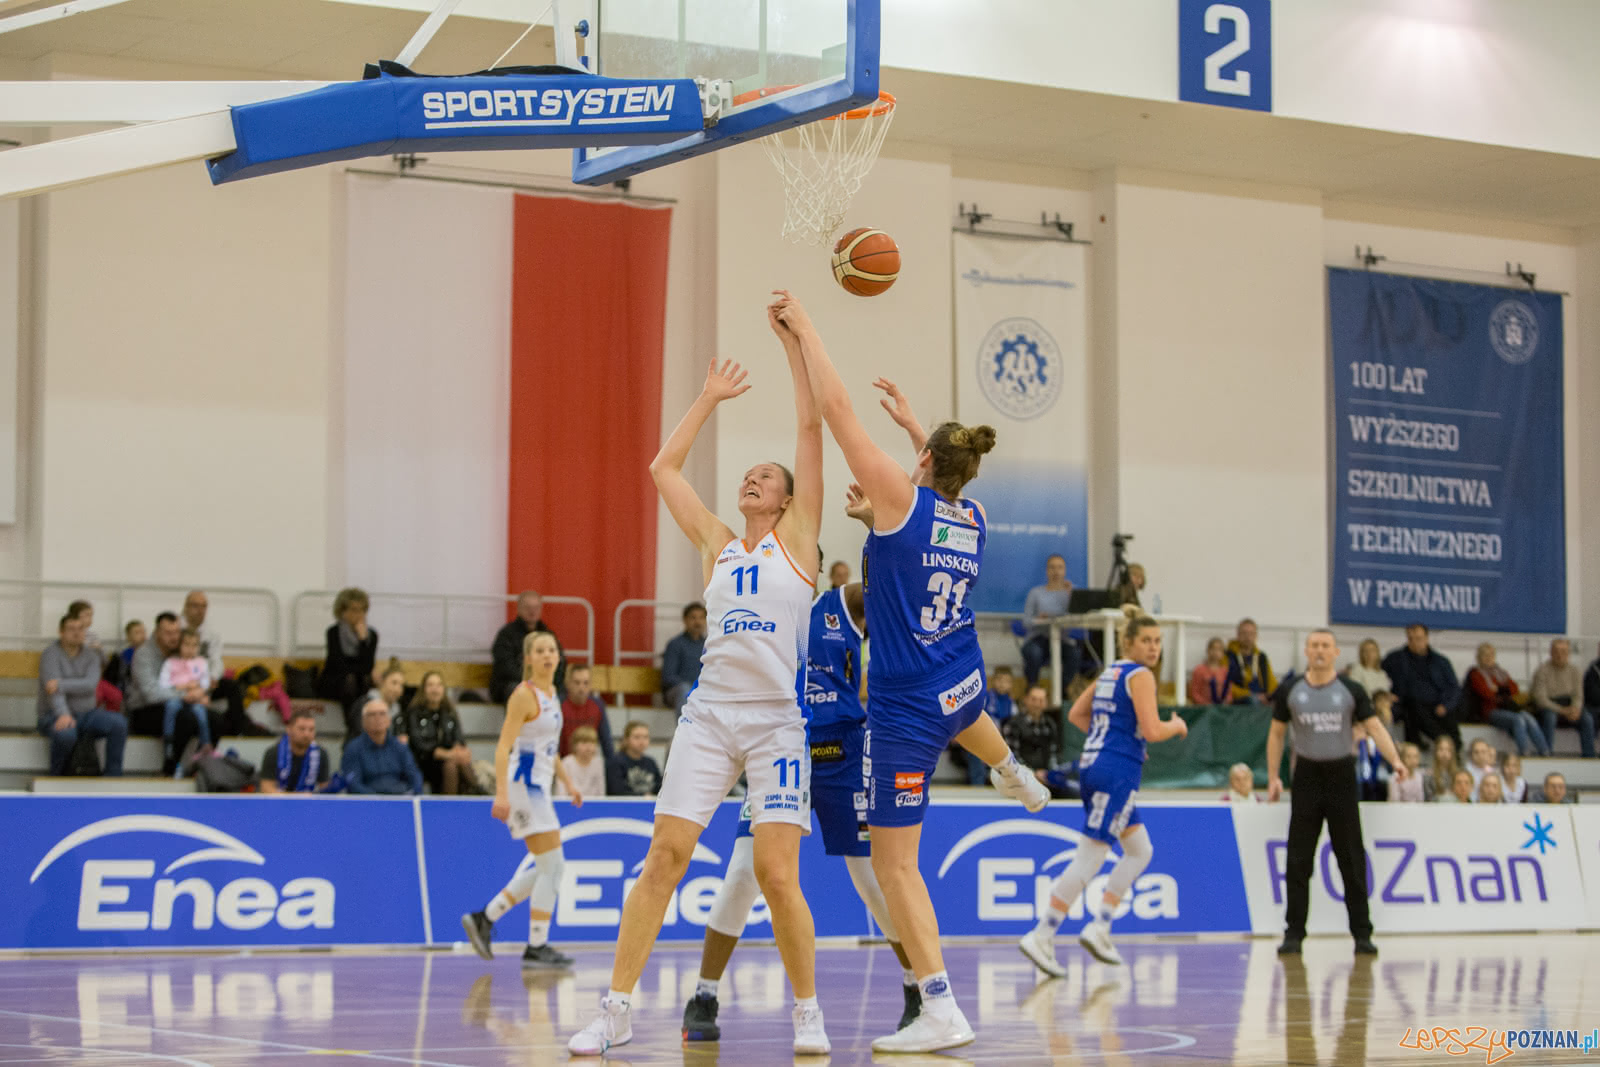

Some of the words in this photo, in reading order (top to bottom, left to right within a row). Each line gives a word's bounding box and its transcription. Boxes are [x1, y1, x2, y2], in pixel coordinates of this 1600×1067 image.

[1204, 3, 1251, 97] 2
[1350, 361, 1387, 390] 100
[1389, 366, 1428, 395] LAT
[1348, 413, 1460, 452] WYŻSZEGO
[1348, 469, 1493, 508] SZKOLNICTWA
[1347, 523, 1502, 562] TECHNICZNEGO
[731, 564, 759, 596] 11
[922, 552, 979, 577] LINSKENS
[920, 571, 970, 632] 31
[1347, 578, 1372, 606] W
[1376, 580, 1481, 614] POZNANIU
[723, 618, 777, 635] Enea
[804, 690, 838, 704] nea
[773, 757, 800, 789] 11
[77, 859, 336, 931] Enea
